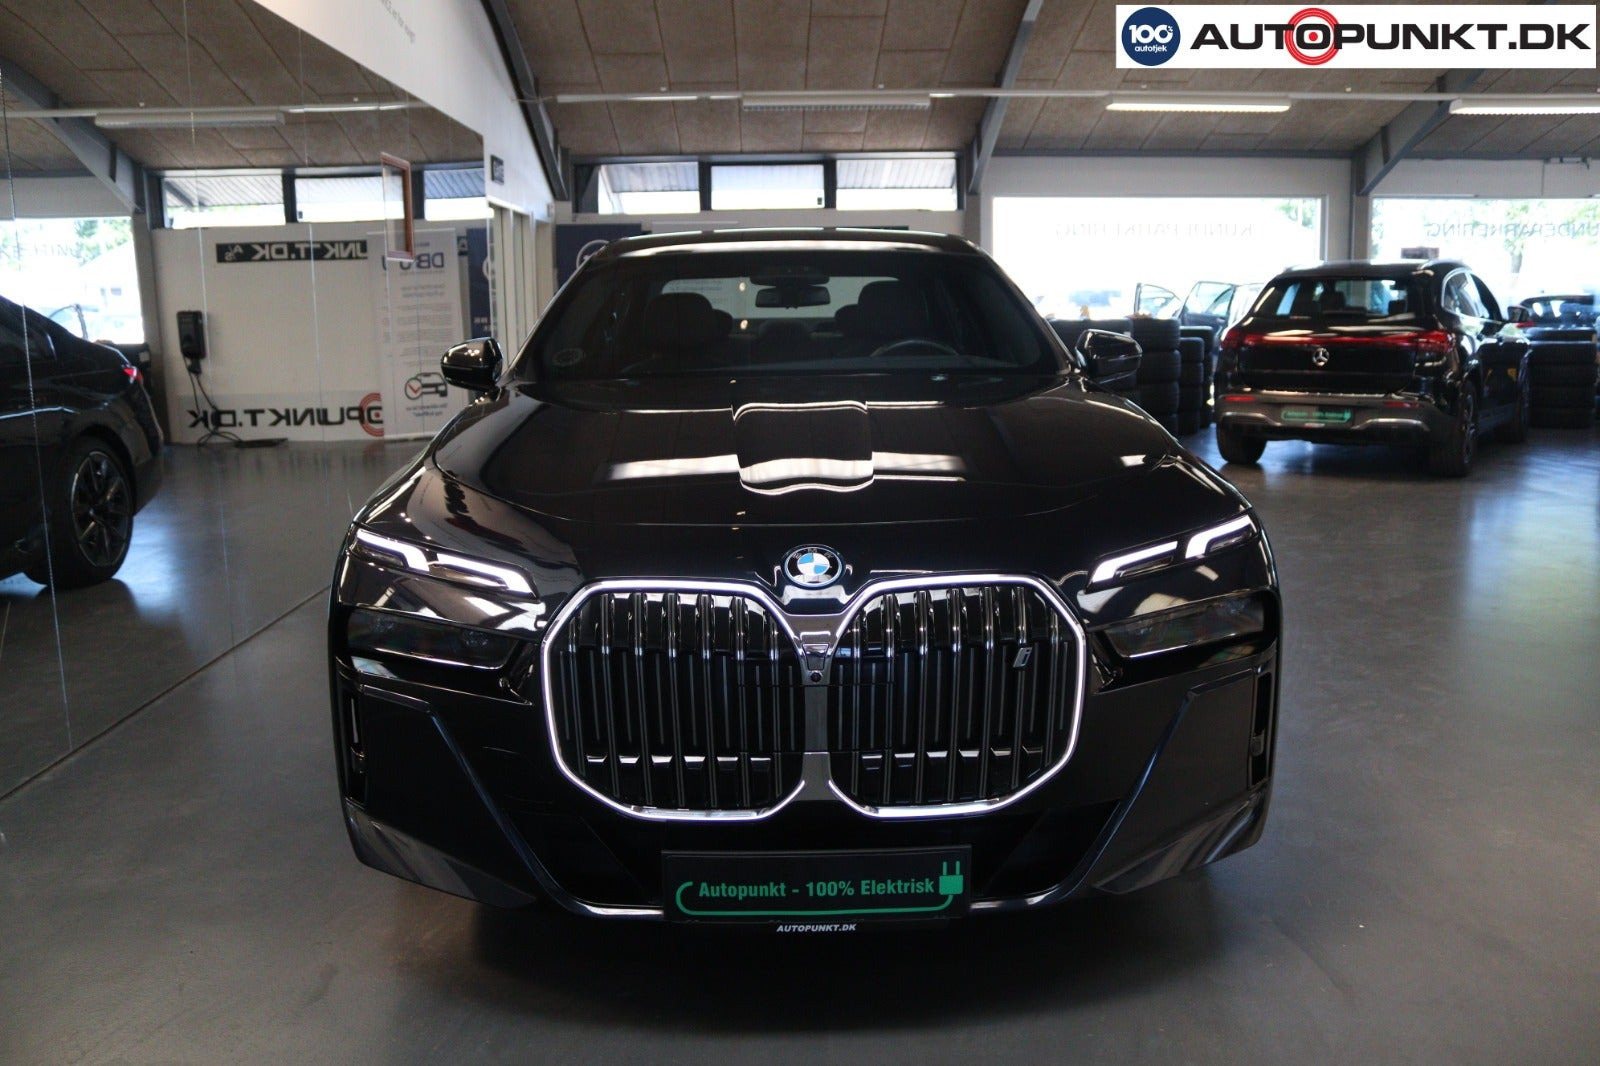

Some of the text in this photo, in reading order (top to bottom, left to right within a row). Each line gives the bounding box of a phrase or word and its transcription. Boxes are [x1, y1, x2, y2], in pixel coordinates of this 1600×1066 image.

[699, 881, 786, 901] Autopunkt
[805, 881, 855, 897] 100%
[861, 878, 934, 896] Elektrisk
[776, 923, 857, 933] AUTOPUNKT.DK
